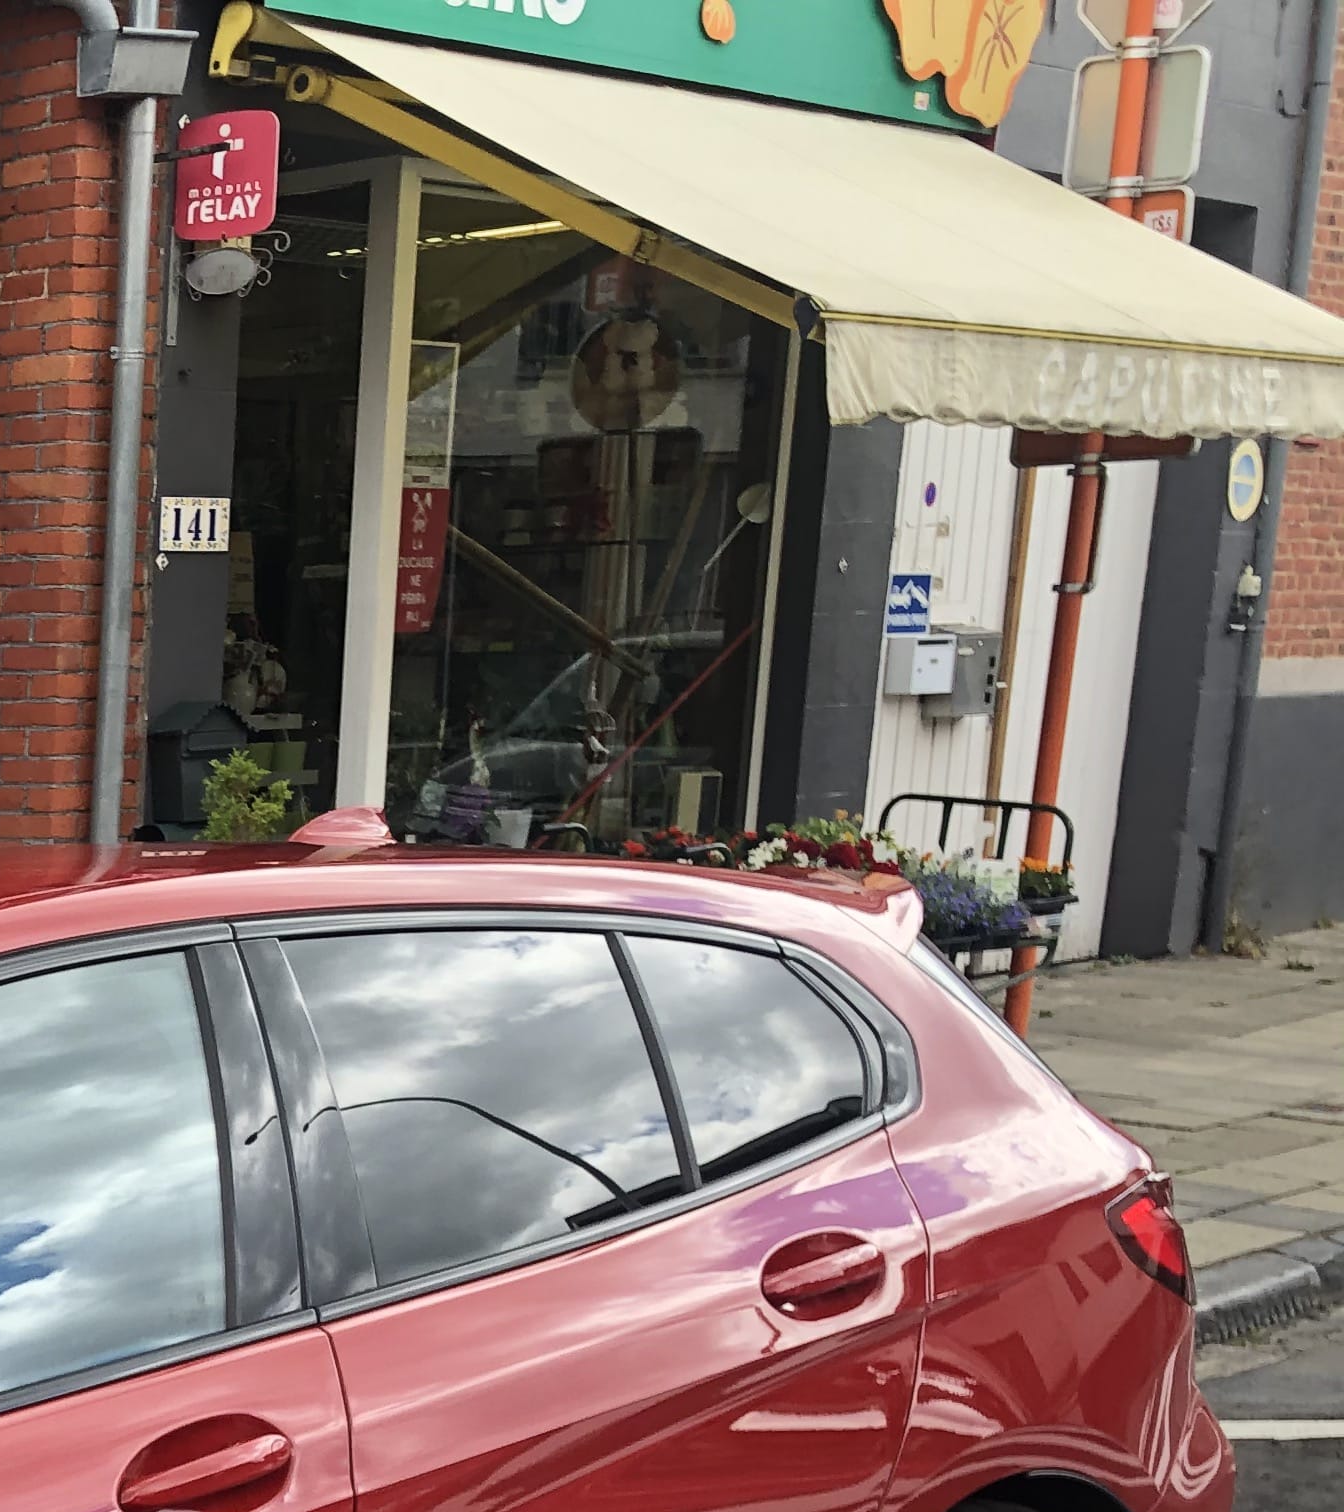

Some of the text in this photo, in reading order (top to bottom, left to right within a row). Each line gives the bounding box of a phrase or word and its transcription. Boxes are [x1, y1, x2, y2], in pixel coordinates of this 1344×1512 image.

[188, 181, 262, 199] MONDIAL
[187, 193, 262, 225] RELAY
[172, 507, 217, 542] 141
